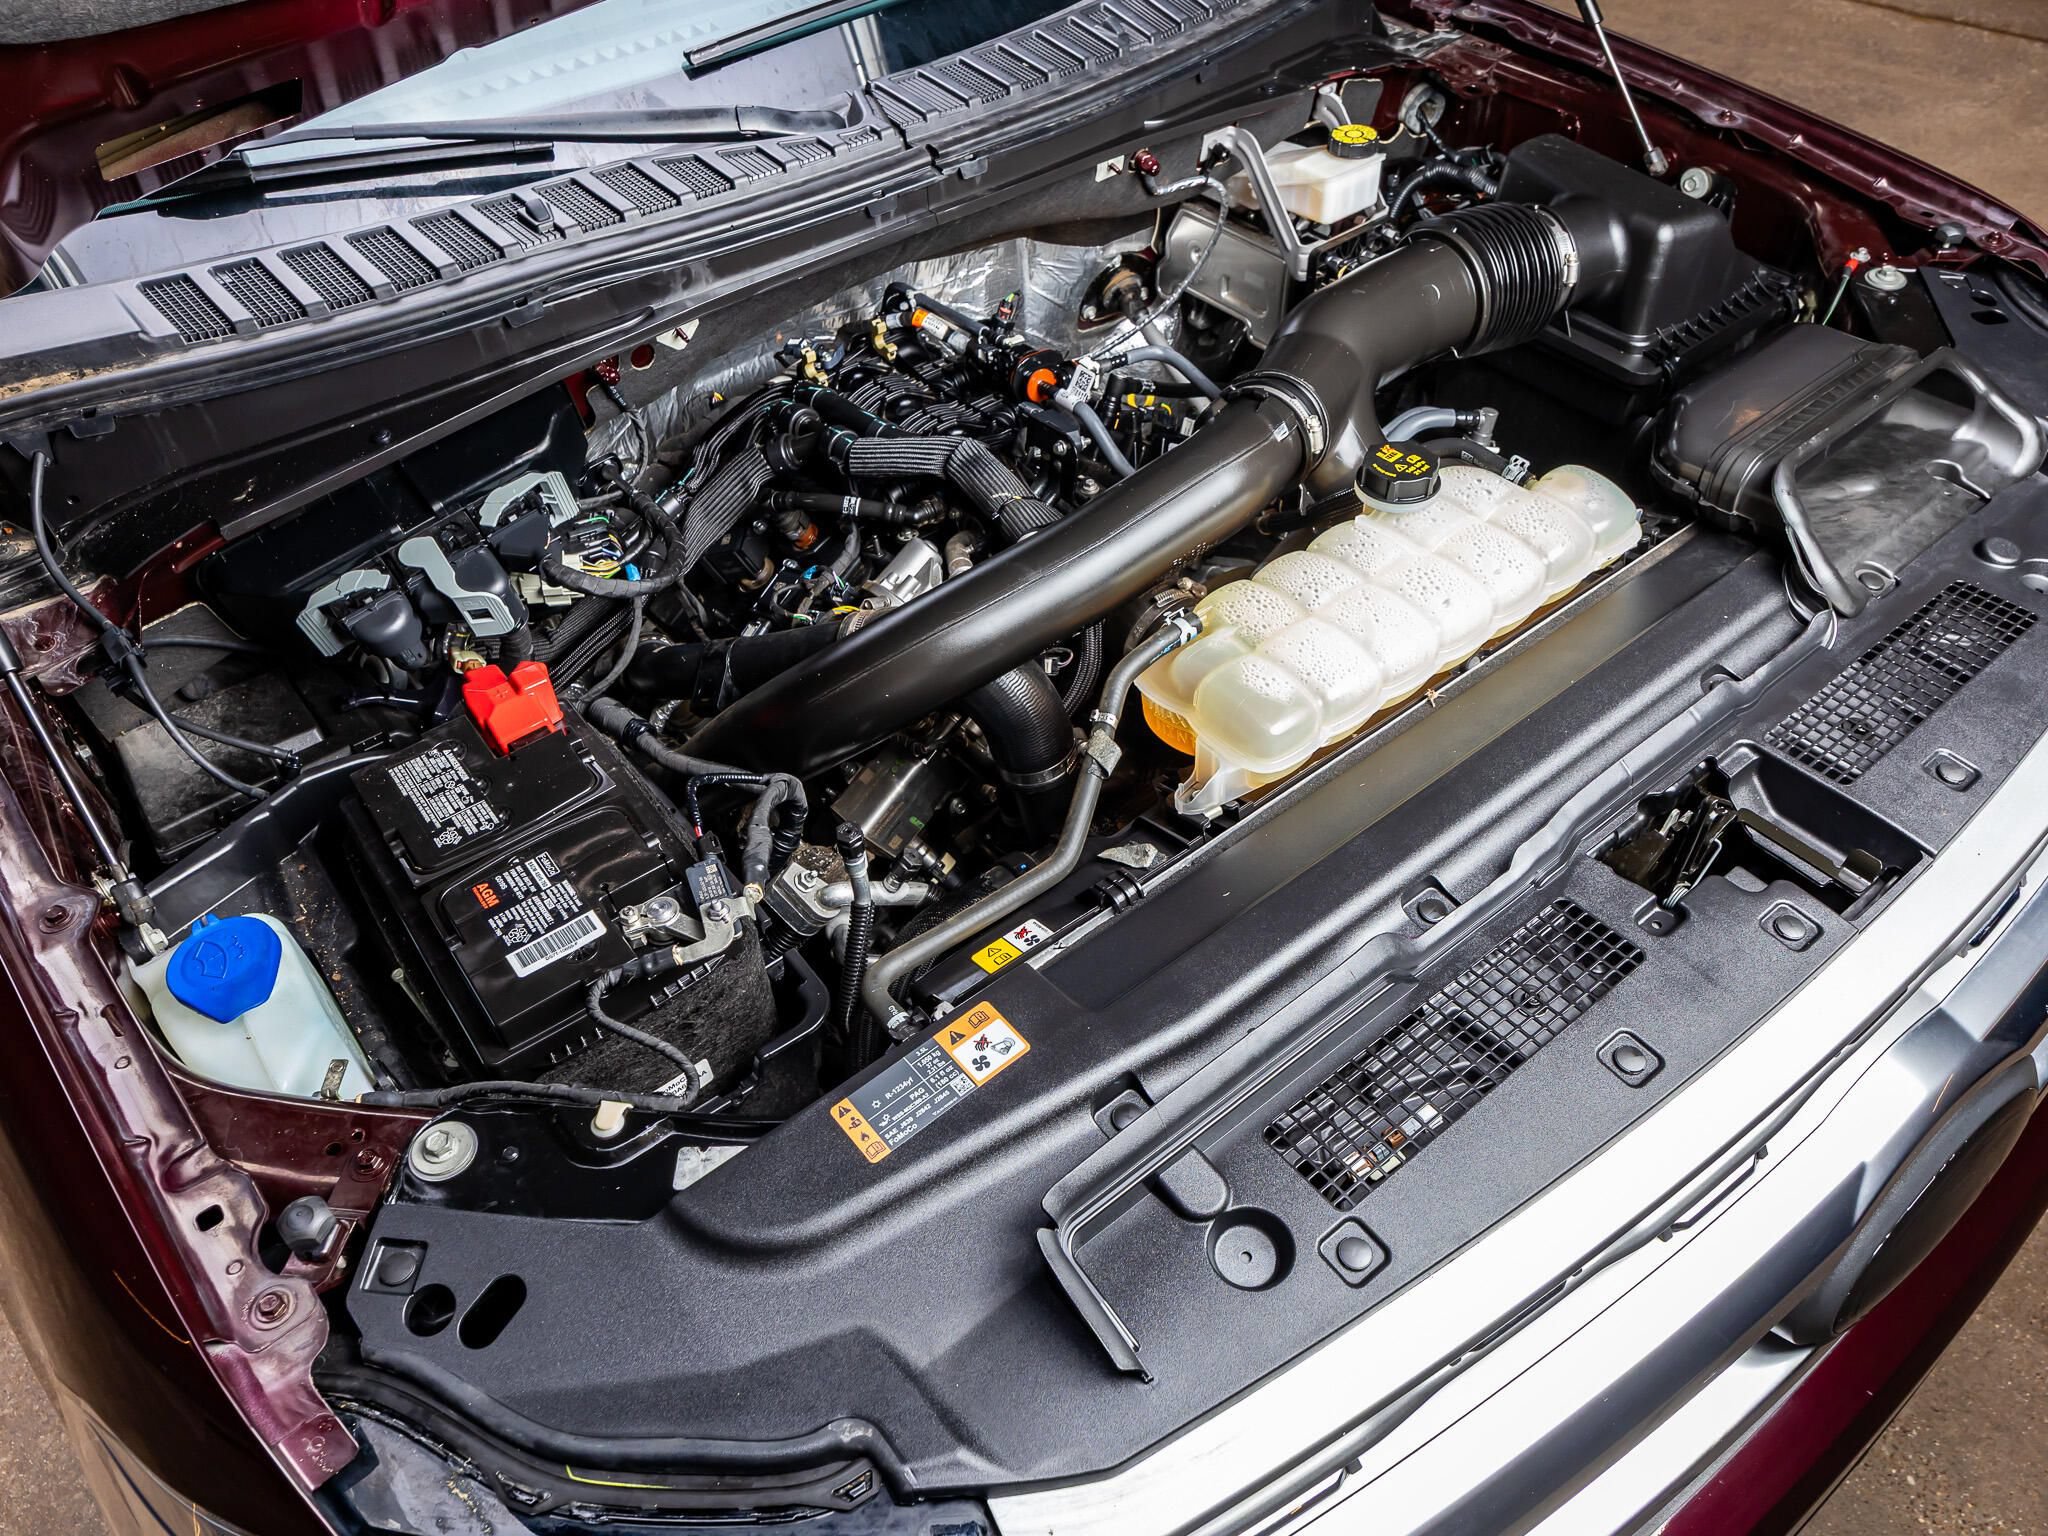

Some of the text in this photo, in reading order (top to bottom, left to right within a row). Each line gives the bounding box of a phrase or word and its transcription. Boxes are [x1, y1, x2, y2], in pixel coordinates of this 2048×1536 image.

[476, 880, 499, 907] AGM
[931, 1048, 941, 1058] kg
[884, 1076, 914, 1100] R-1234yf
[909, 1086, 925, 1100] PAG
[884, 1127, 898, 1140] SAE
[888, 1122, 918, 1146] FoMoCo
